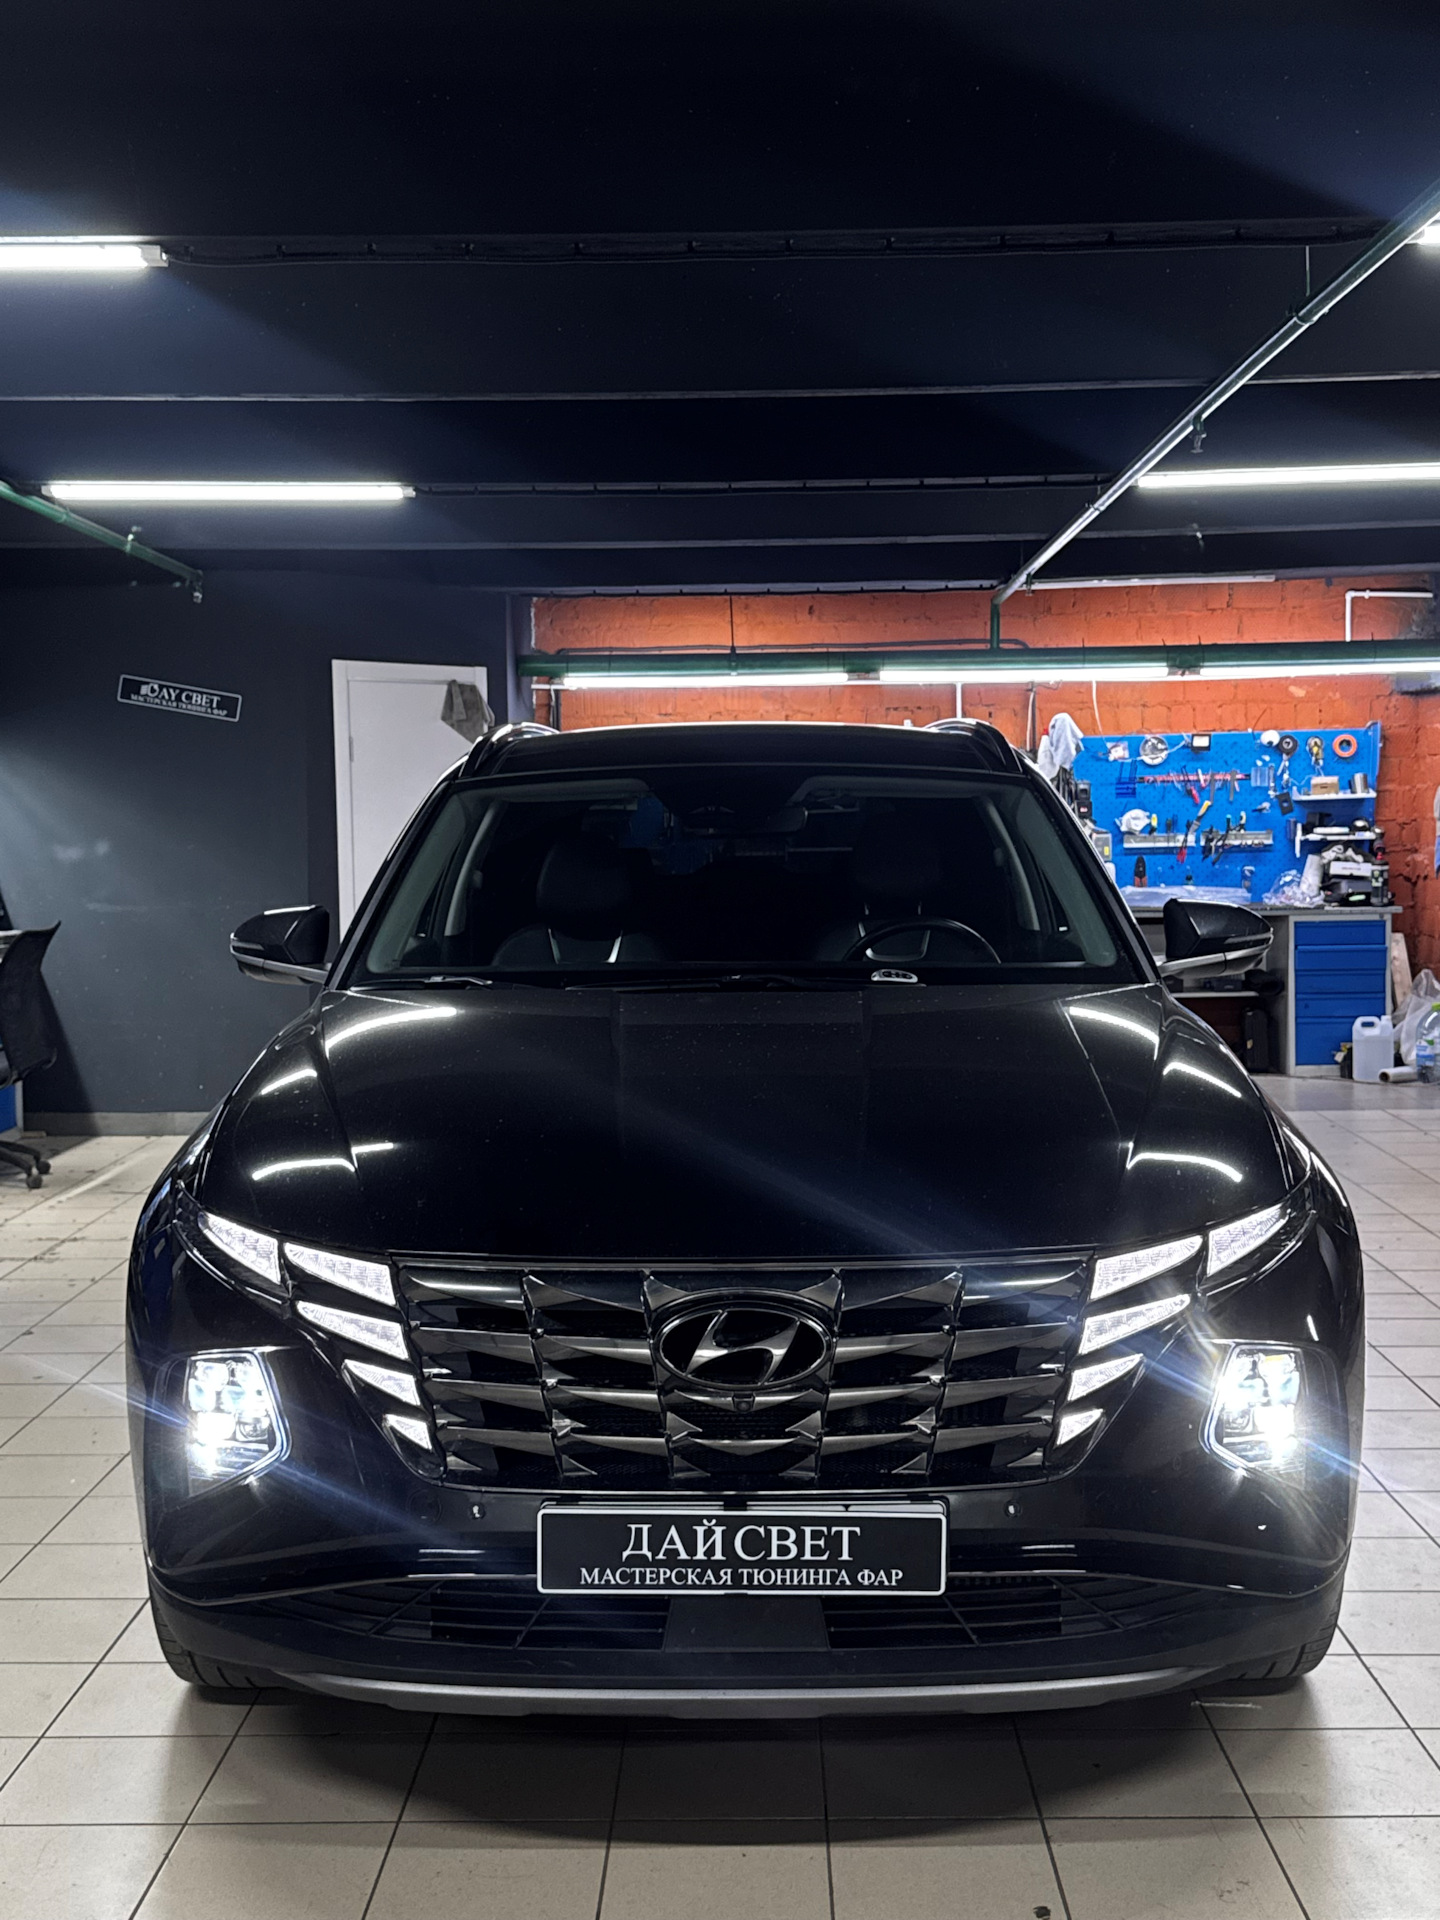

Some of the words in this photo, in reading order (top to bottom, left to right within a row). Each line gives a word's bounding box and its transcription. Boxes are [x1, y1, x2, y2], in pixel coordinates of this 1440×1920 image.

[181, 691, 221, 708] СВЕТ
[622, 1518, 727, 1562] ДАЙ
[733, 1524, 861, 1561] СВЕТ
[580, 1567, 733, 1586] МАСТЕРСКАЯ
[737, 1568, 852, 1586] ТЮНИНГА
[857, 1568, 904, 1587] ФАР
